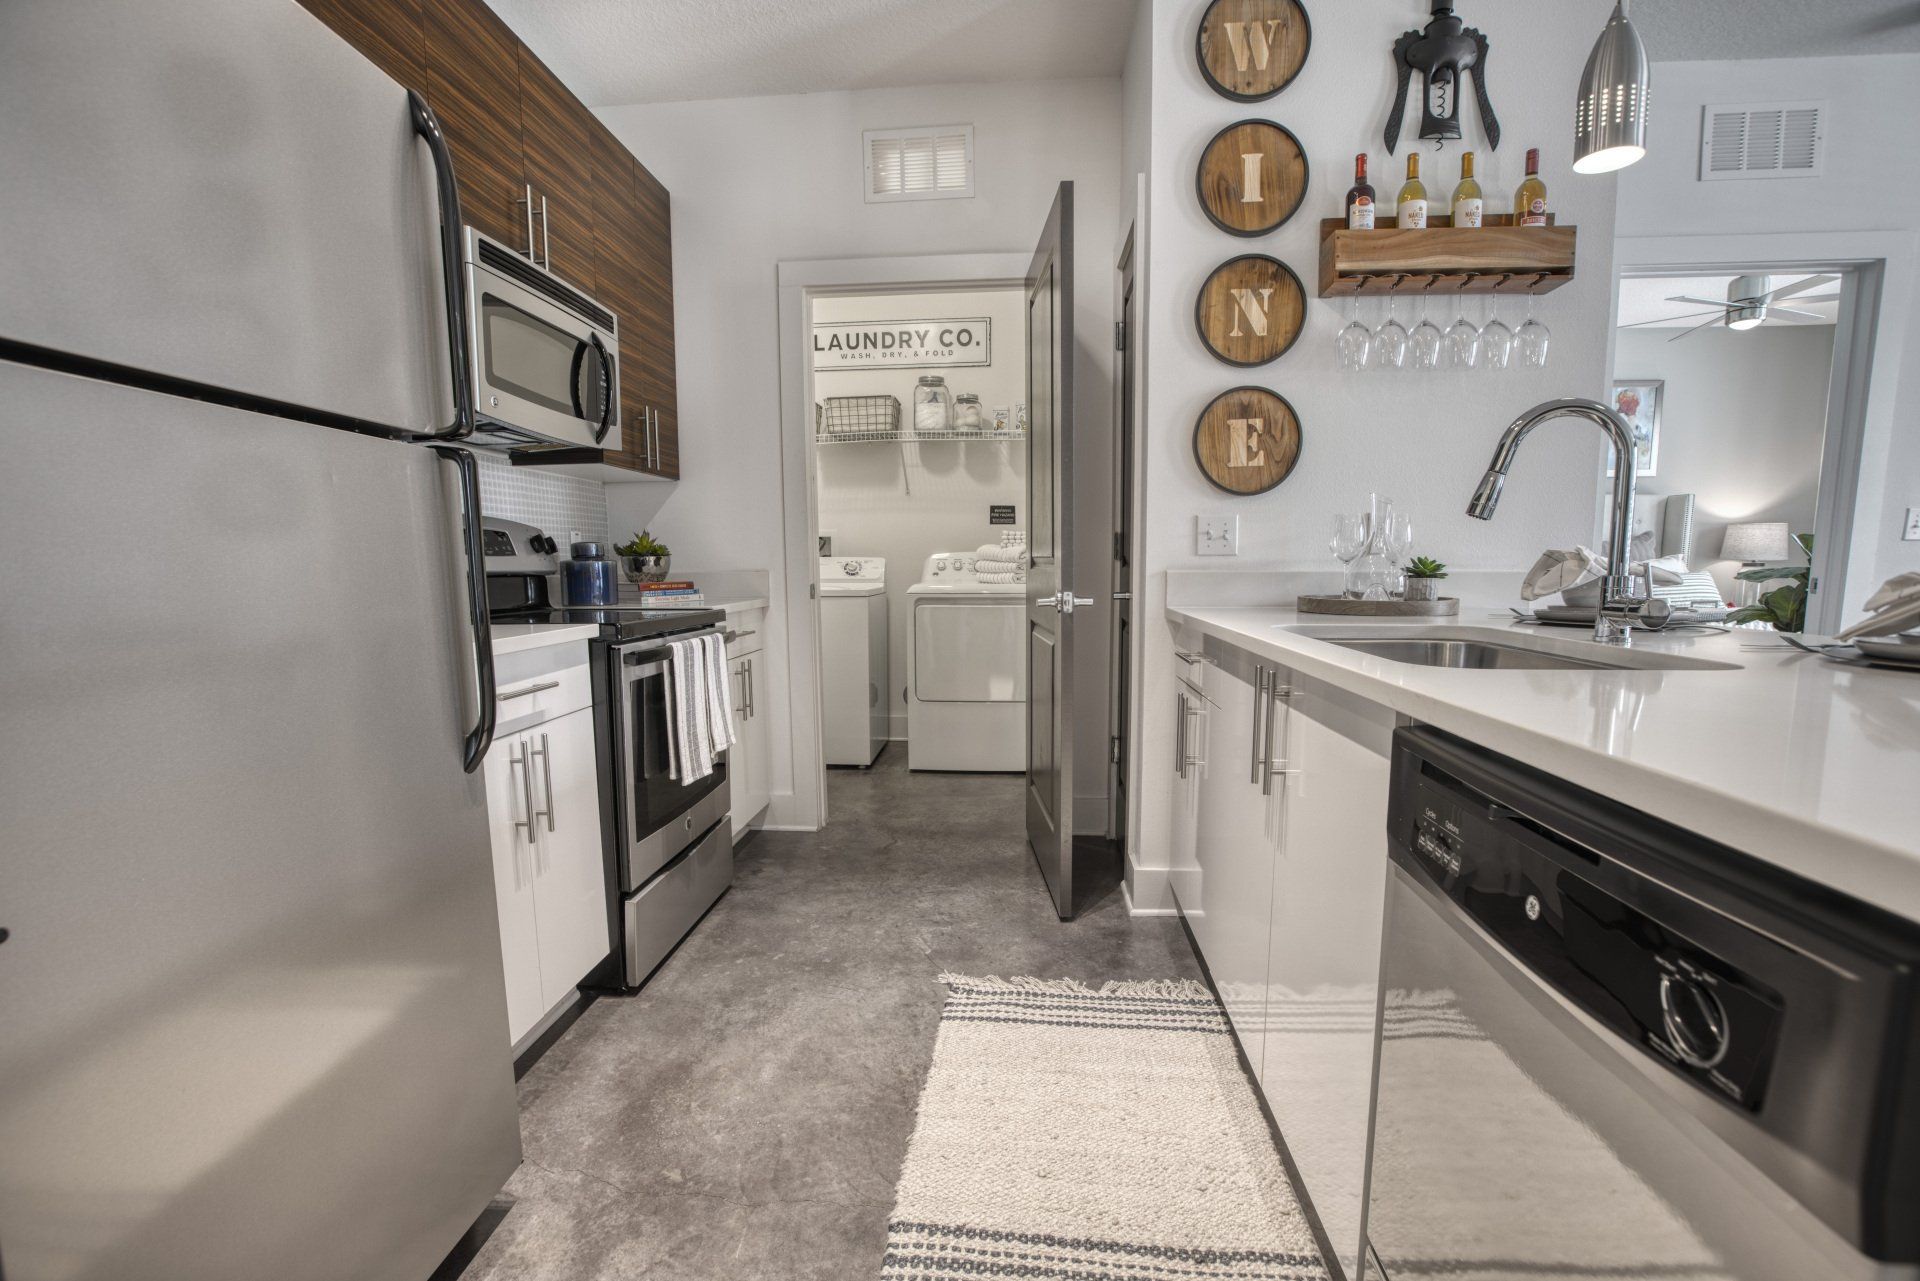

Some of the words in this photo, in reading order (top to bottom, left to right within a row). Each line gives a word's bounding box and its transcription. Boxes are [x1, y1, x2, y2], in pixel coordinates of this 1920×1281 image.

[814, 330, 930, 351] LAUNDRY
[939, 328, 980, 347] CO.
[840, 352, 876, 360] WASH,
[1425, 807, 1436, 819] Cycles
[1445, 820, 1460, 834] Options
